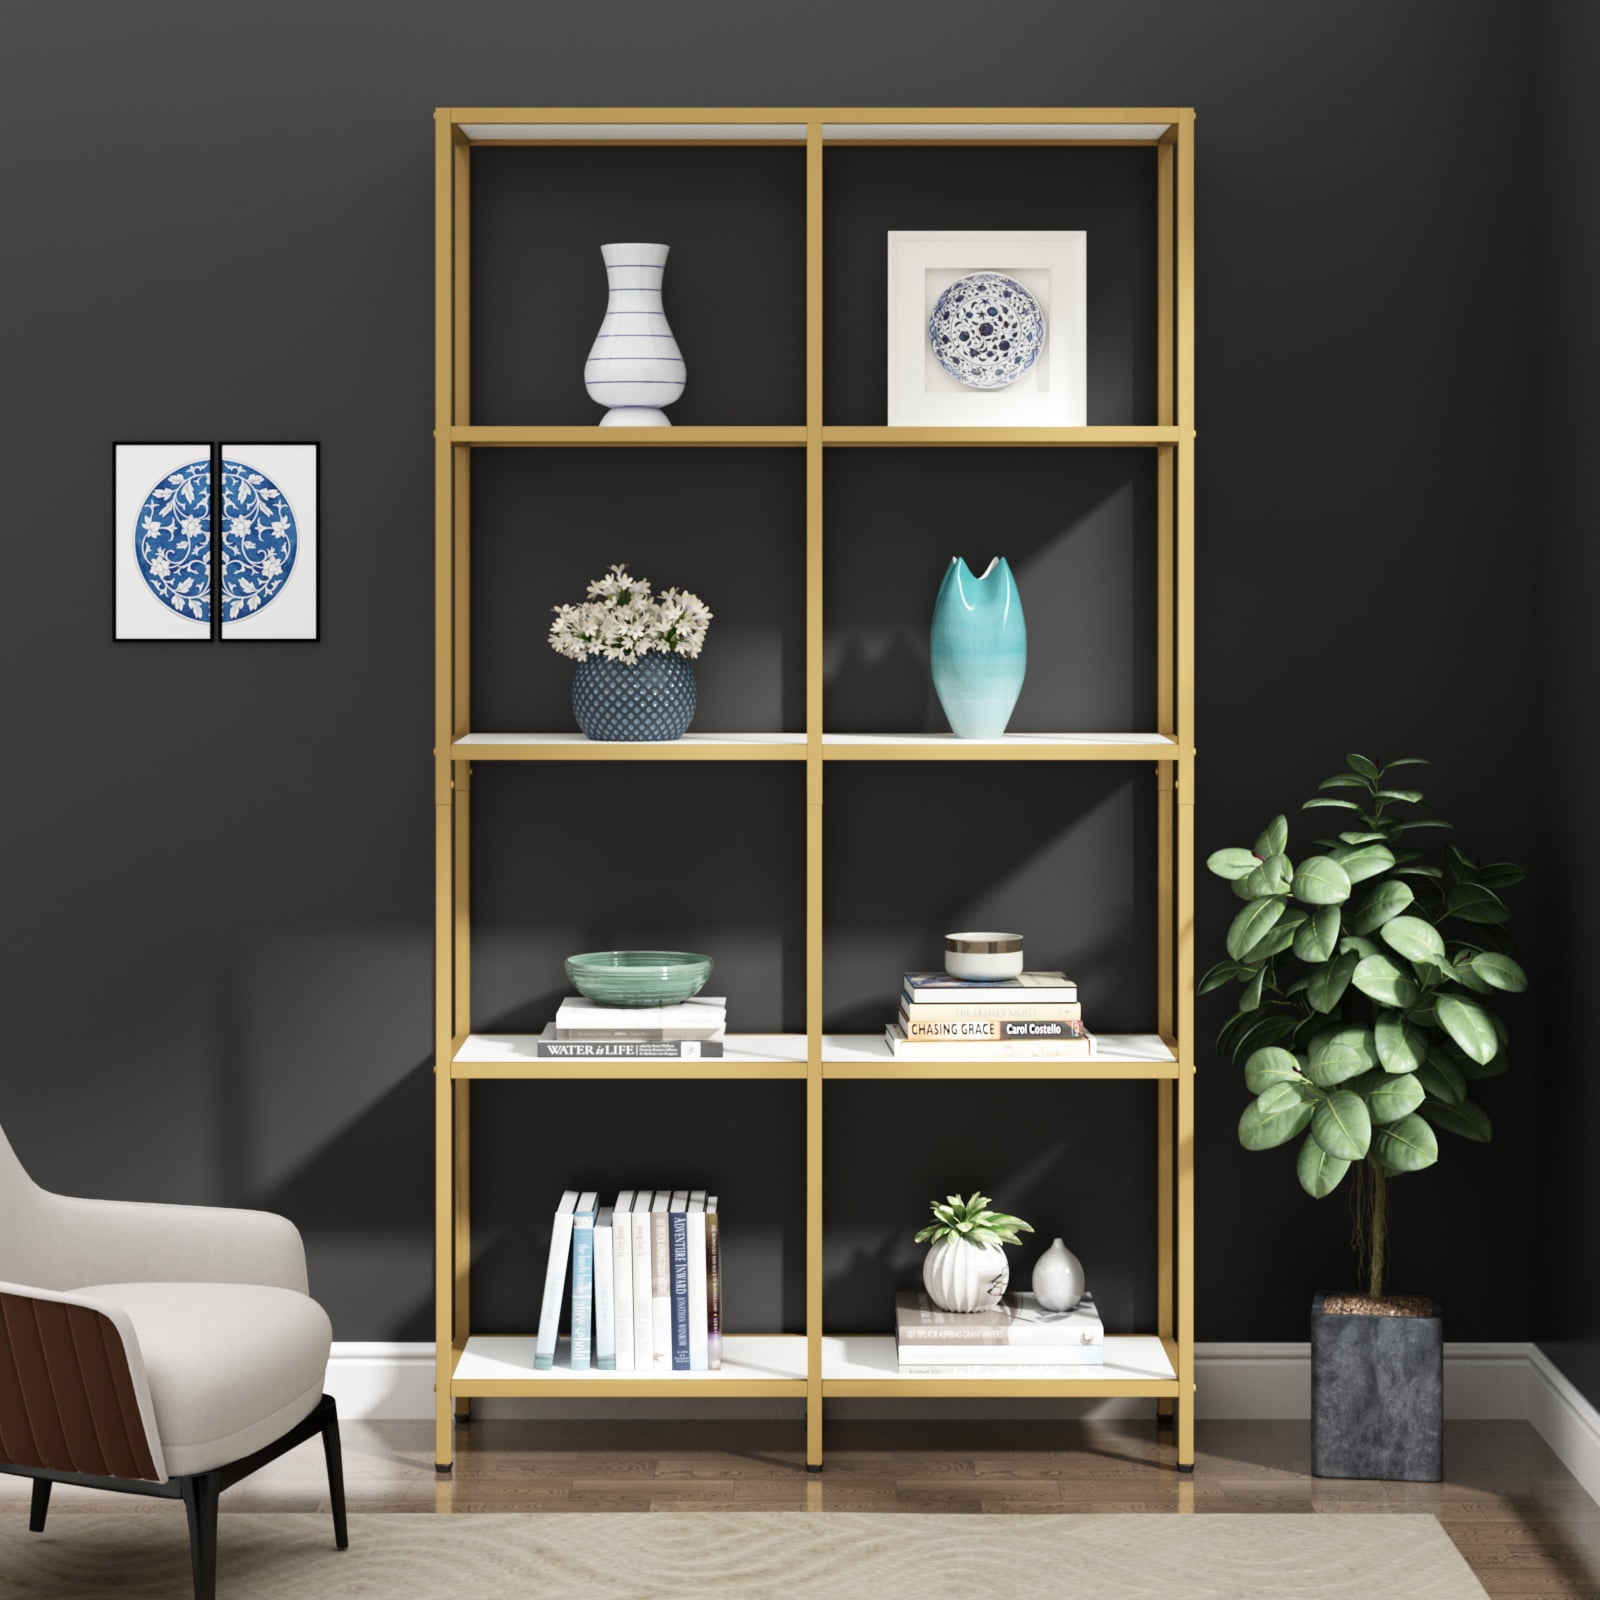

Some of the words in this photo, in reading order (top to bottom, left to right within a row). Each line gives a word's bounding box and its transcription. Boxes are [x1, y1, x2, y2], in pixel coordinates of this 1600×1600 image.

[955, 1007, 970, 1017] THE
[973, 1007, 1006, 1017] ARABIAN
[1008, 1006, 1038, 1017] NIGHTS
[911, 1023, 958, 1036] CHASING
[961, 1023, 995, 1035] GRACE
[1006, 1023, 1027, 1035] Carol
[1029, 1023, 1061, 1035] Costello
[547, 1044, 595, 1055] WATER
[595, 1044, 606, 1055] is
[605, 1044, 635, 1055] LIFE
[674, 1217, 687, 1262] ADVENTURE
[675, 1263, 688, 1295] INWARD
[575, 1300, 591, 1324] alice
[676, 1296, 686, 1322] JONATHAN
[574, 1327, 591, 1360] sebold
